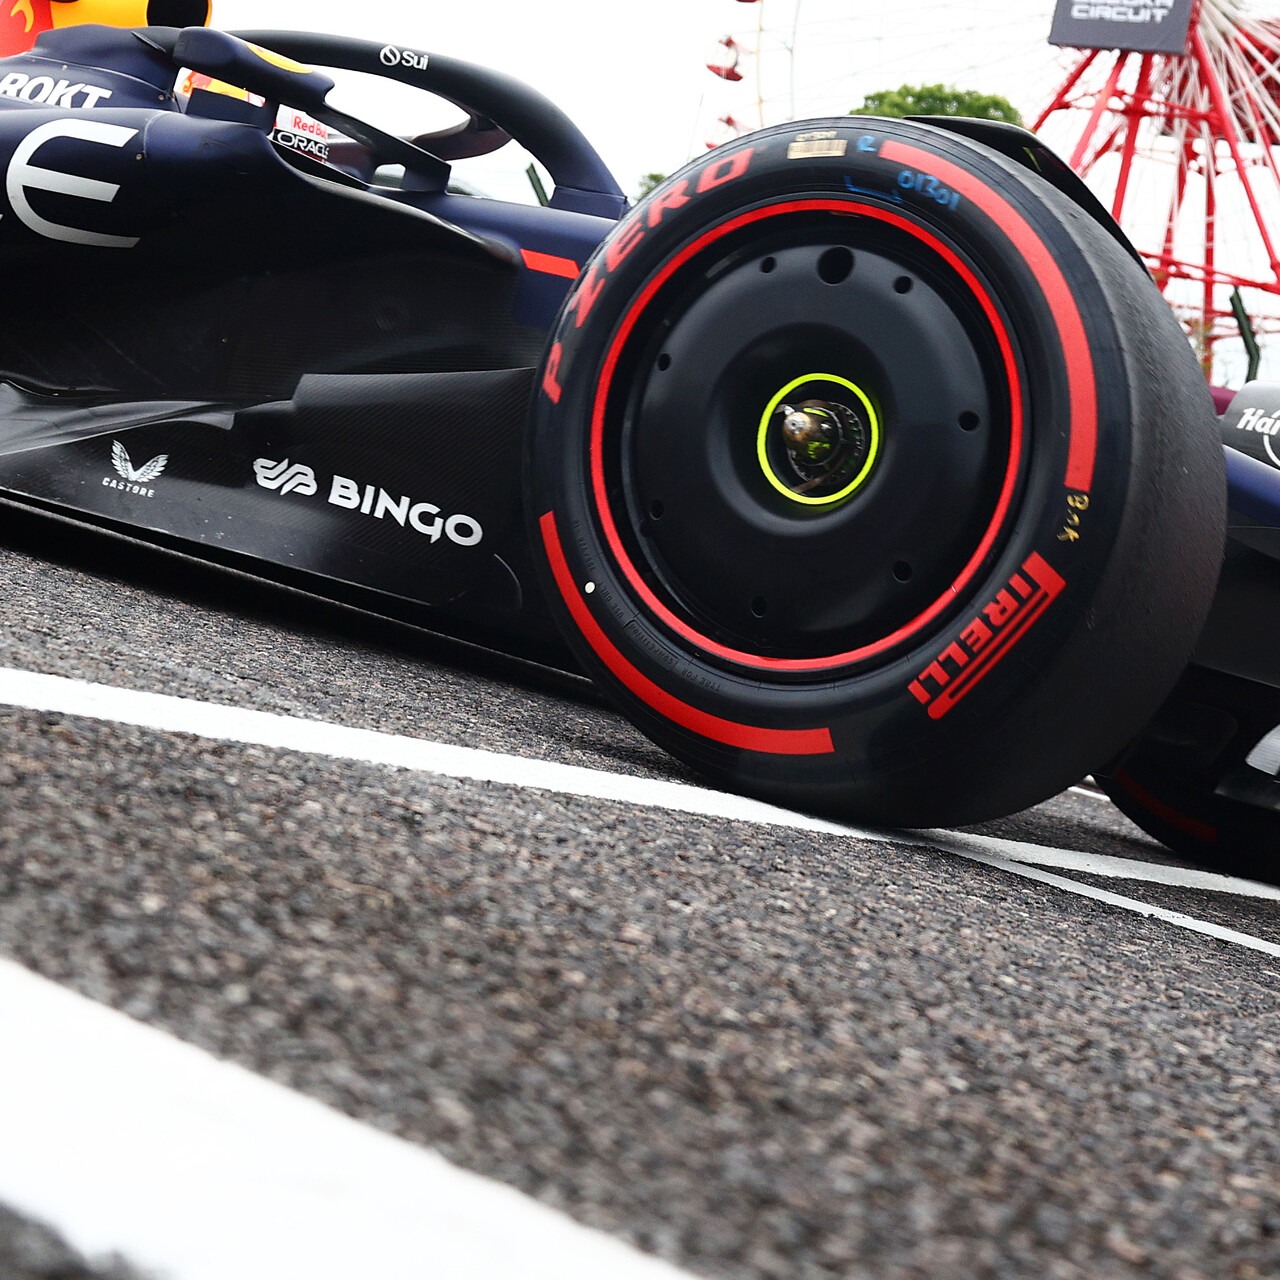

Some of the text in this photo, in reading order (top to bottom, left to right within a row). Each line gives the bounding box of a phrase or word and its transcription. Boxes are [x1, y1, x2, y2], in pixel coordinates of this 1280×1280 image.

[1070, 5, 1169, 24] CIRCUIT
[401, 50, 429, 71] Sui
[293, 115, 315, 133] Red
[541, 147, 755, 404] P ZERO
[101, 477, 156, 498] CASTORE
[328, 474, 483, 546] BINGO
[907, 550, 1067, 720] PIRELLI
